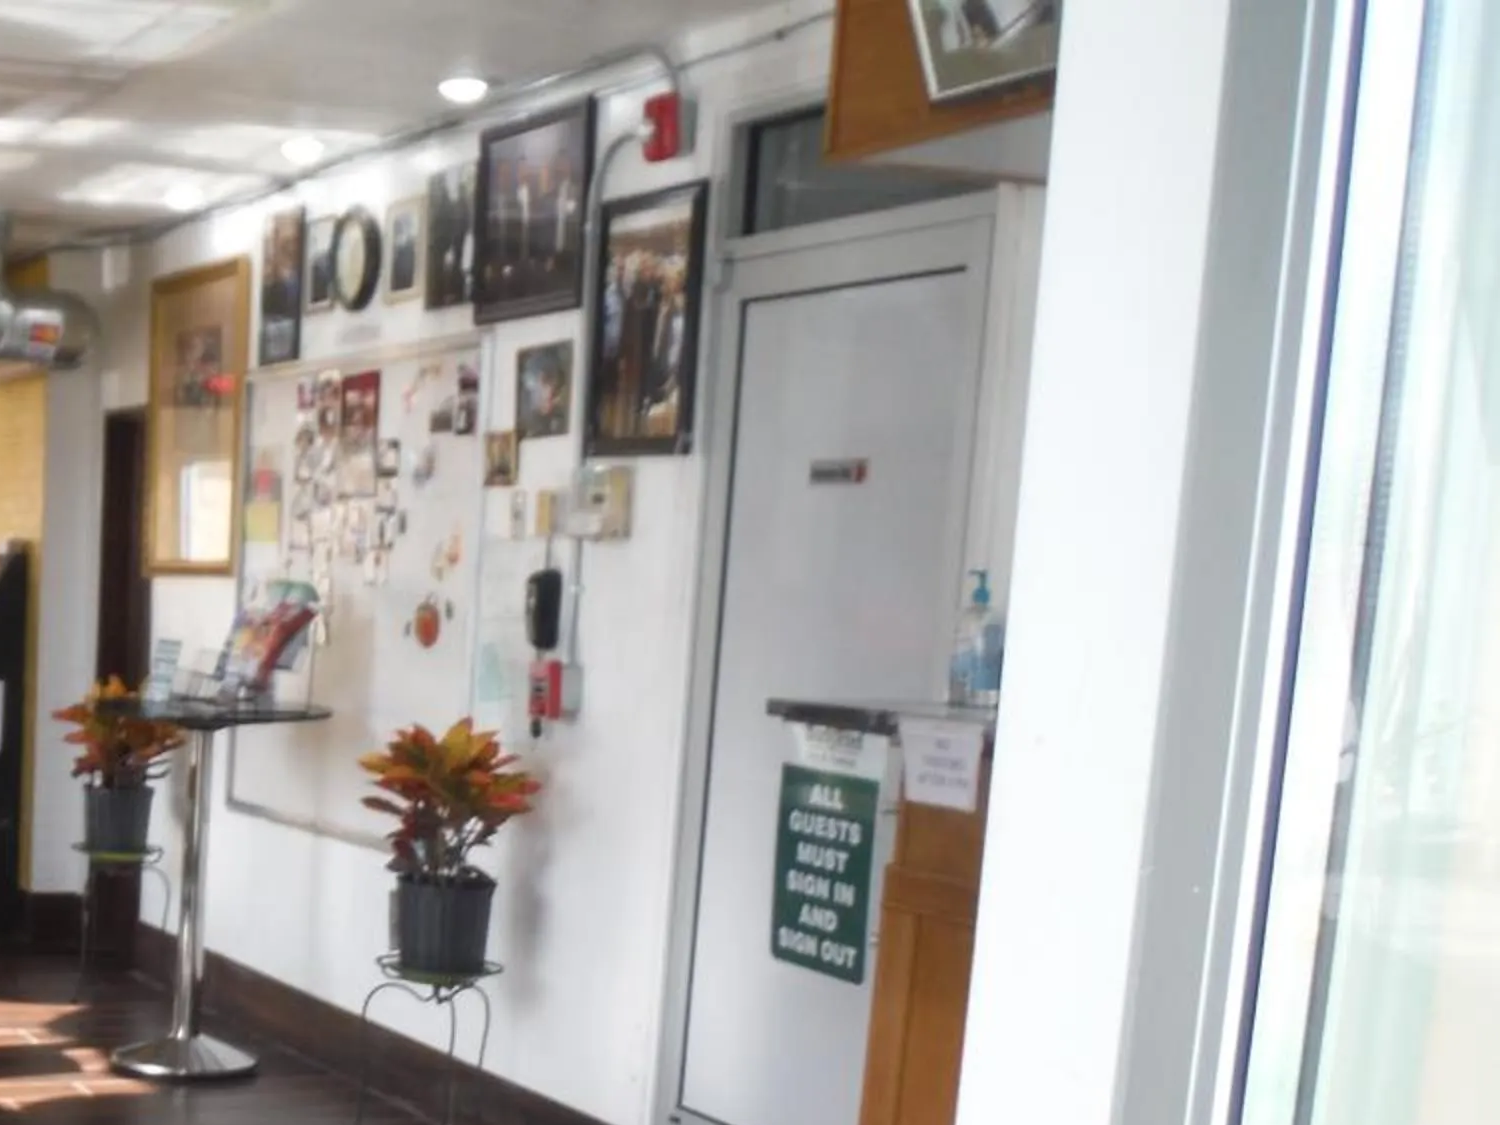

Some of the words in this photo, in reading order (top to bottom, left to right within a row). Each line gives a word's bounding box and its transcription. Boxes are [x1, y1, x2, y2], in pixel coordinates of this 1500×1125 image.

[808, 784, 843, 811] ALL
[789, 809, 862, 845] GUESTS
[796, 841, 849, 873] MUST
[786, 869, 830, 901] SIGN
[833, 881, 856, 907] IN
[798, 903, 838, 933] AND
[778, 926, 817, 957] SIGN
[821, 940, 857, 969] OUT
